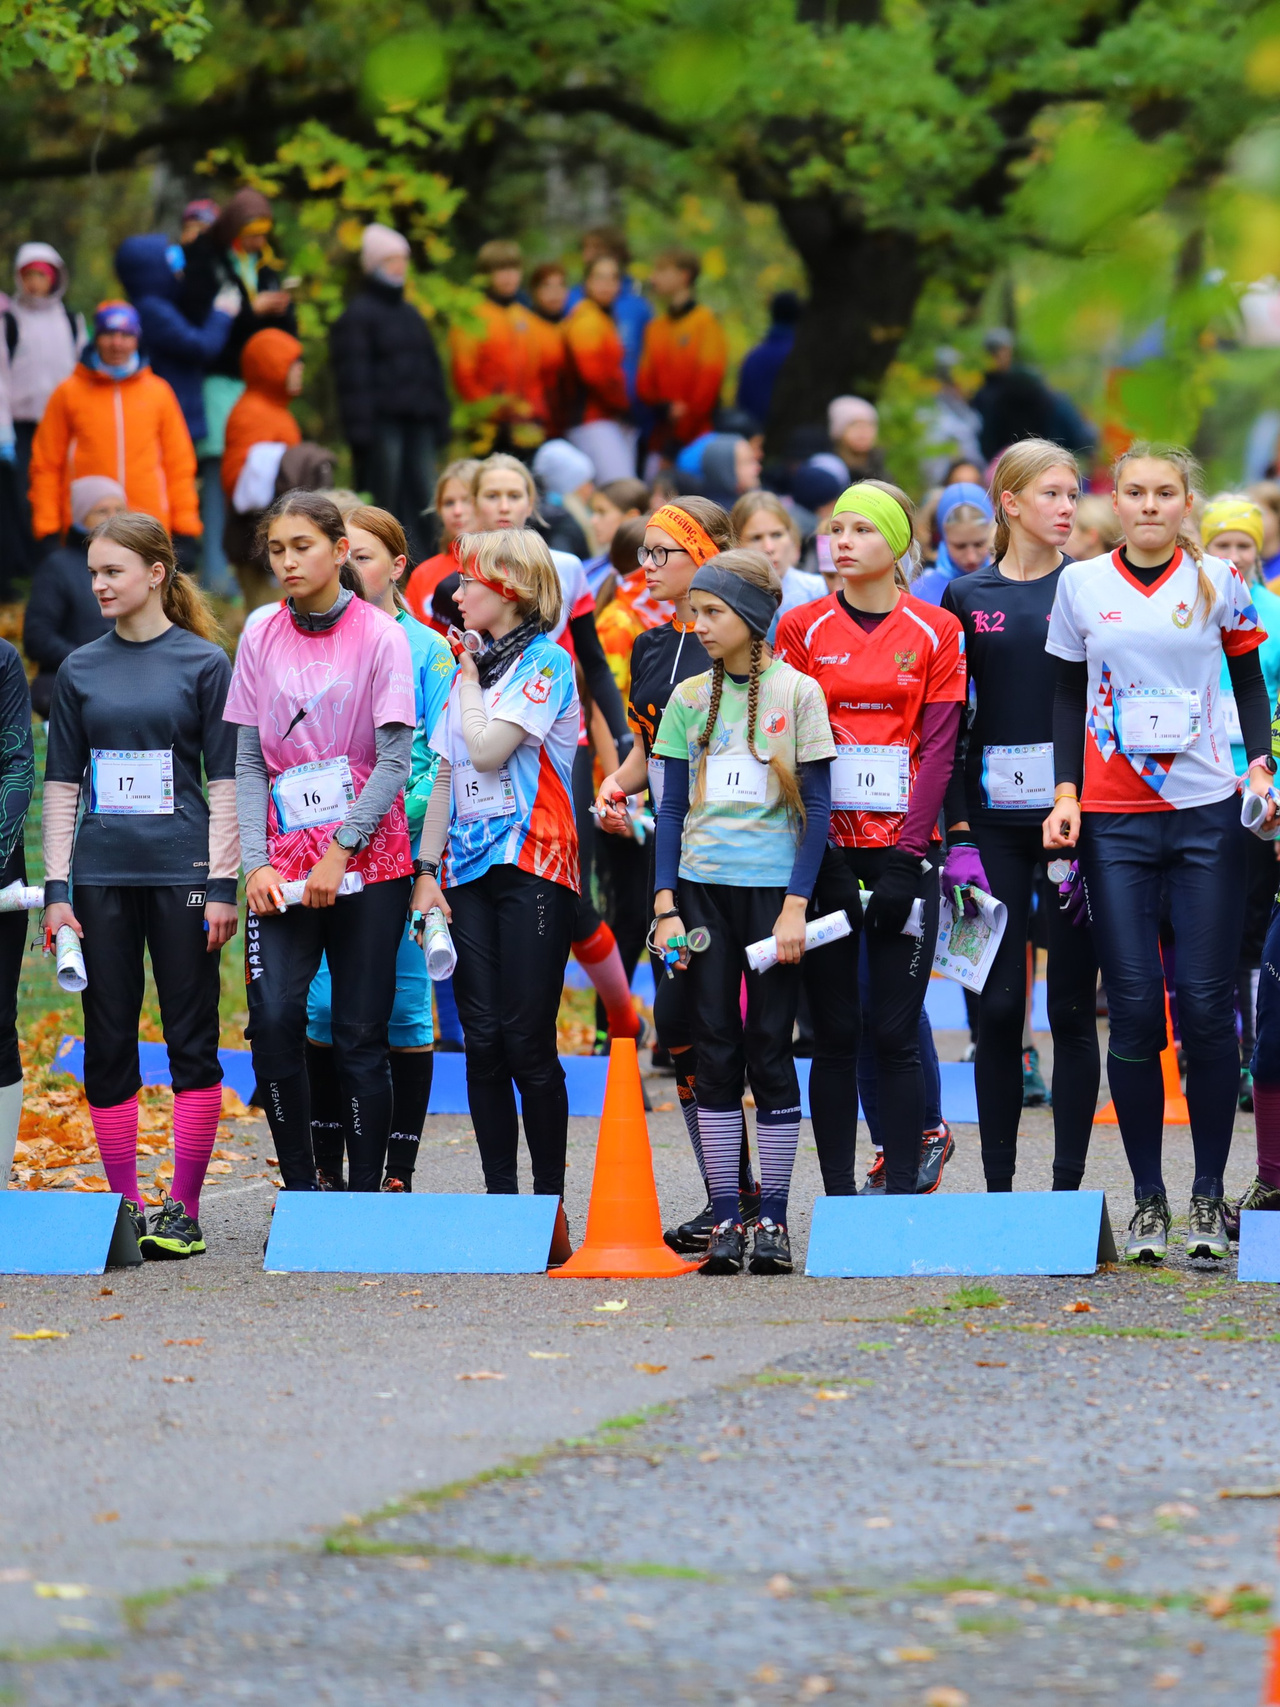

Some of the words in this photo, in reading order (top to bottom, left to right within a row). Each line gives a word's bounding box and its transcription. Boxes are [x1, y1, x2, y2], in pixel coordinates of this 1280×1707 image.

[839, 702, 894, 711] RUSSIA
[1150, 716, 1158, 730] 7
[118, 777, 134, 791] 17
[727, 772, 741, 786] 11
[856, 772, 875, 787] 10
[1014, 771, 1024, 786] 8
[465, 781, 479, 798] 15
[303, 790, 321, 807] 16
